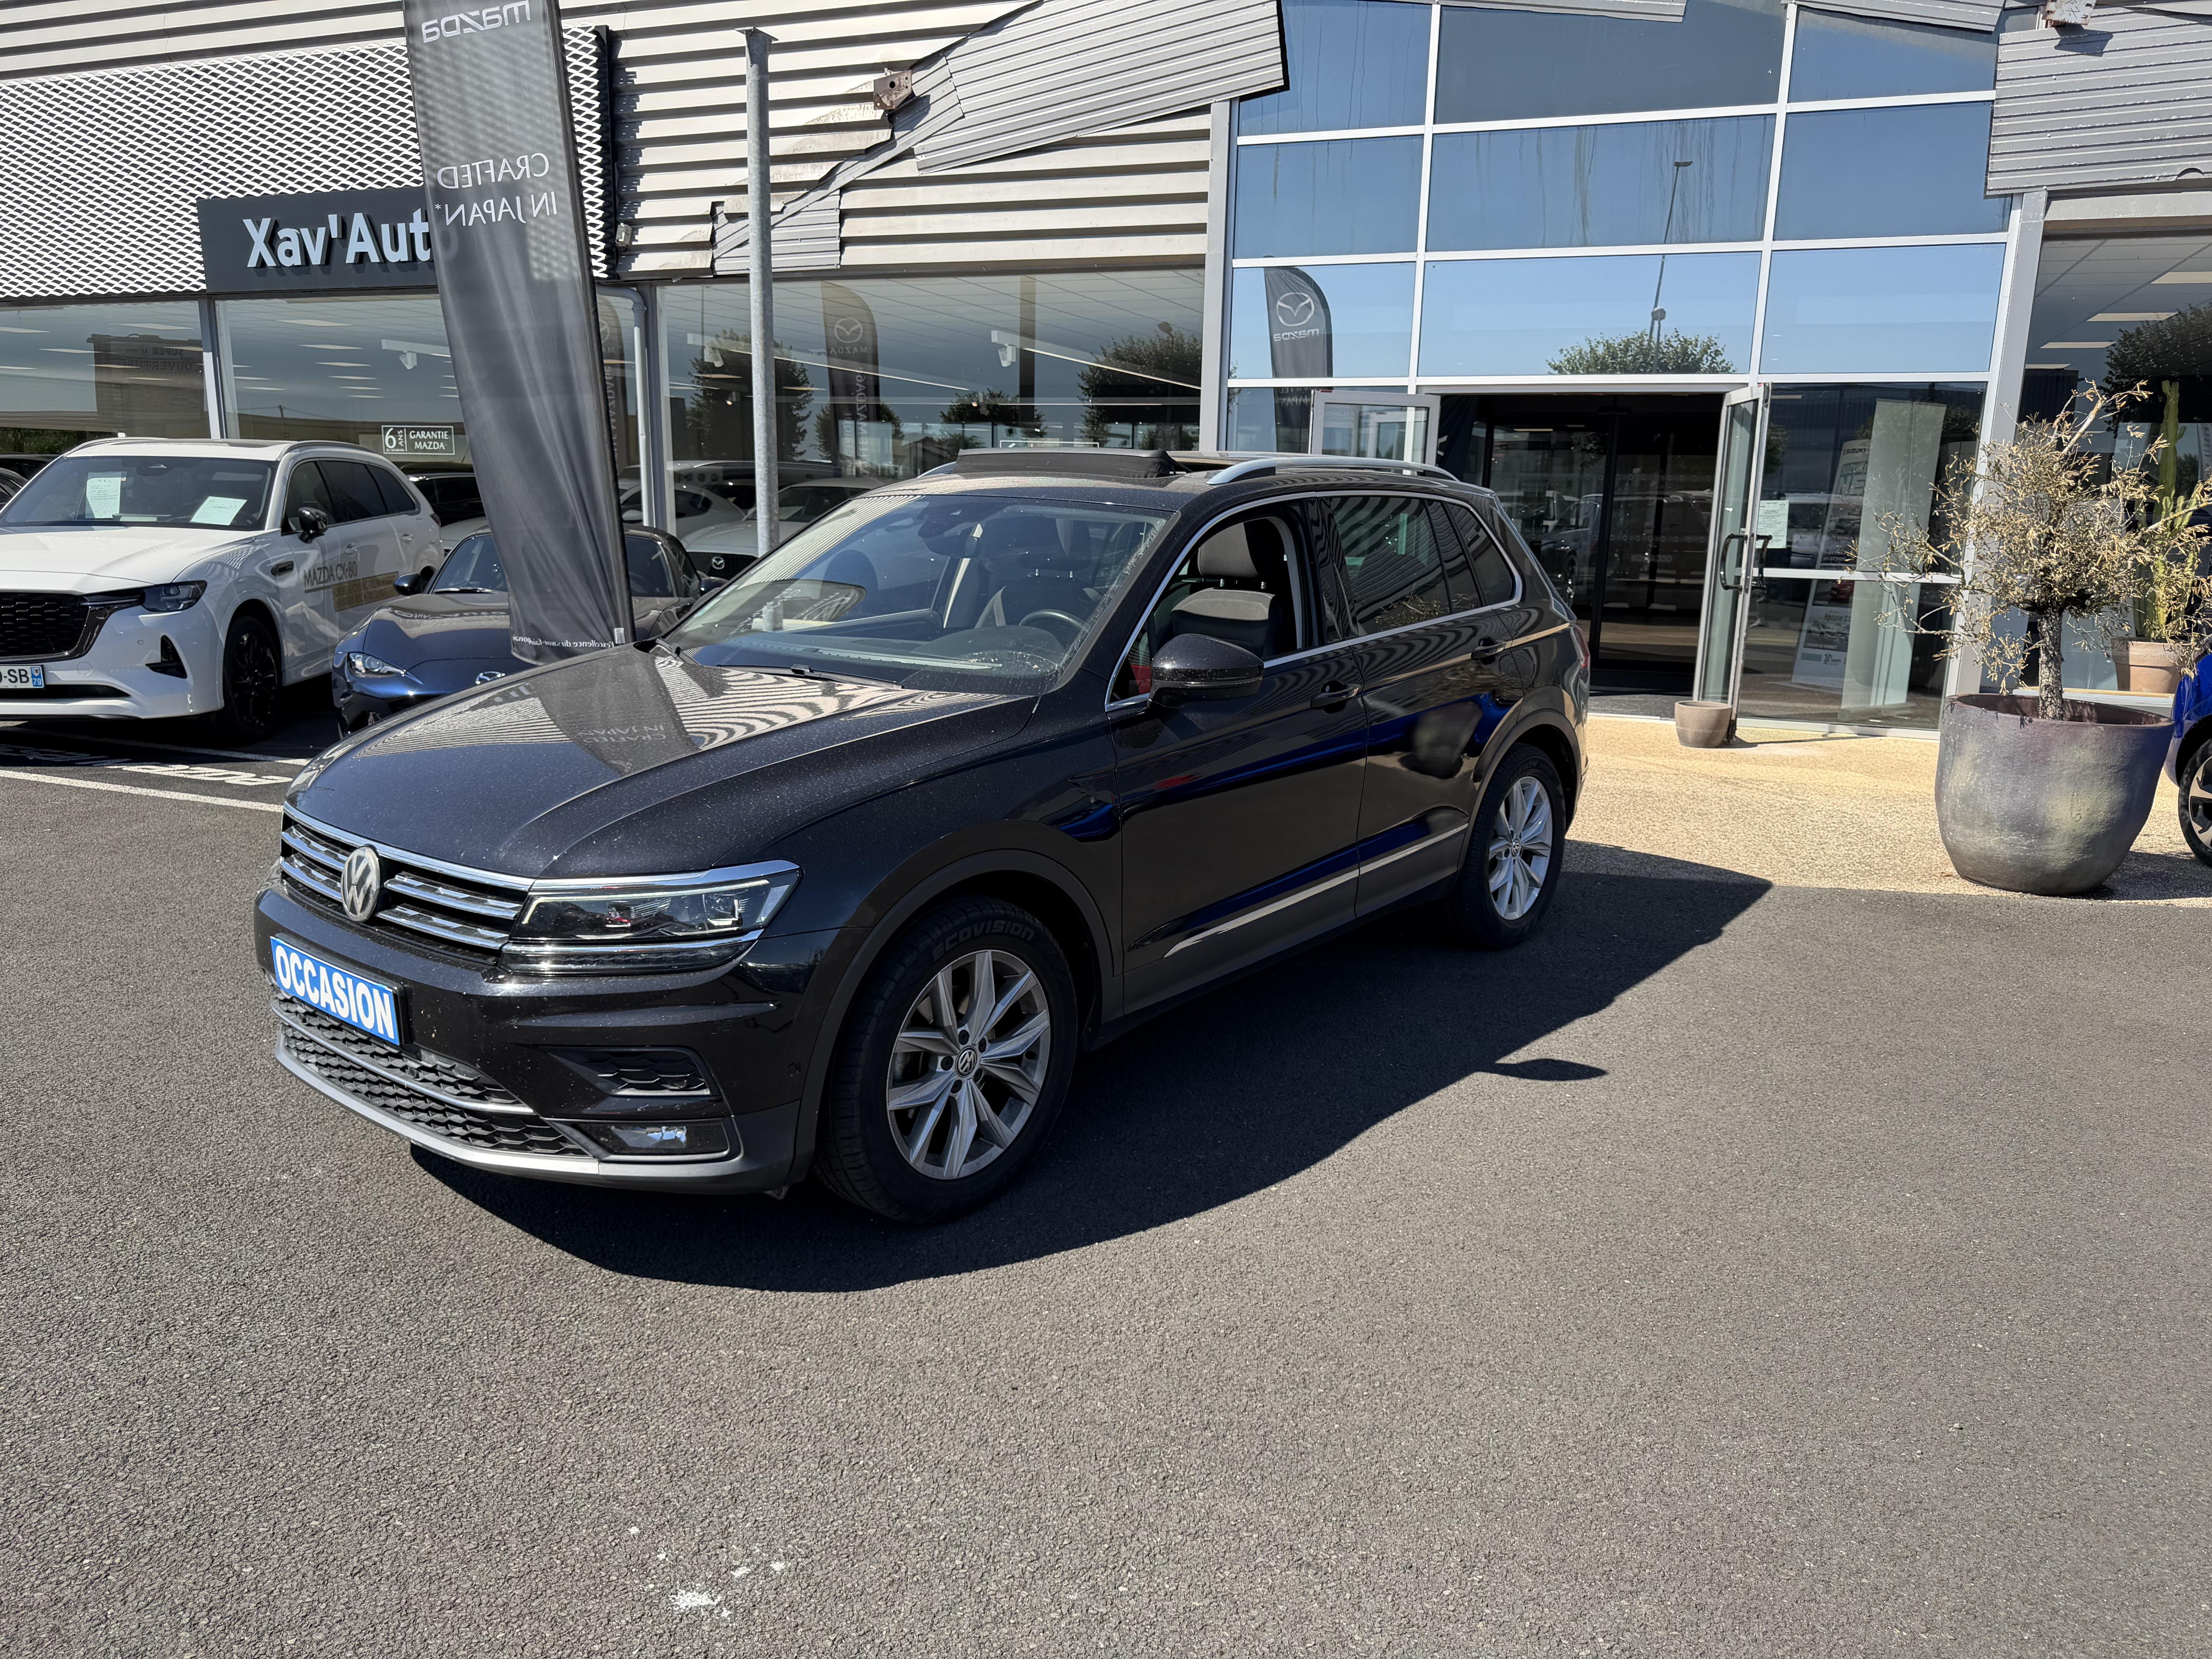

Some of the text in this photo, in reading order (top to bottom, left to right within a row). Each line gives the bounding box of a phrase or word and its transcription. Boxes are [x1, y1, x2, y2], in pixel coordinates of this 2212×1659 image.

[385, 428, 397, 448] 6
[409, 431, 449, 440] GARANTIE
[414, 441, 445, 450] MAZDA
[304, 565, 335, 587] MAZDA
[336, 561, 357, 580] CX-80
[0, 669, 29, 684] -SB
[275, 945, 395, 1039] OCCASION
